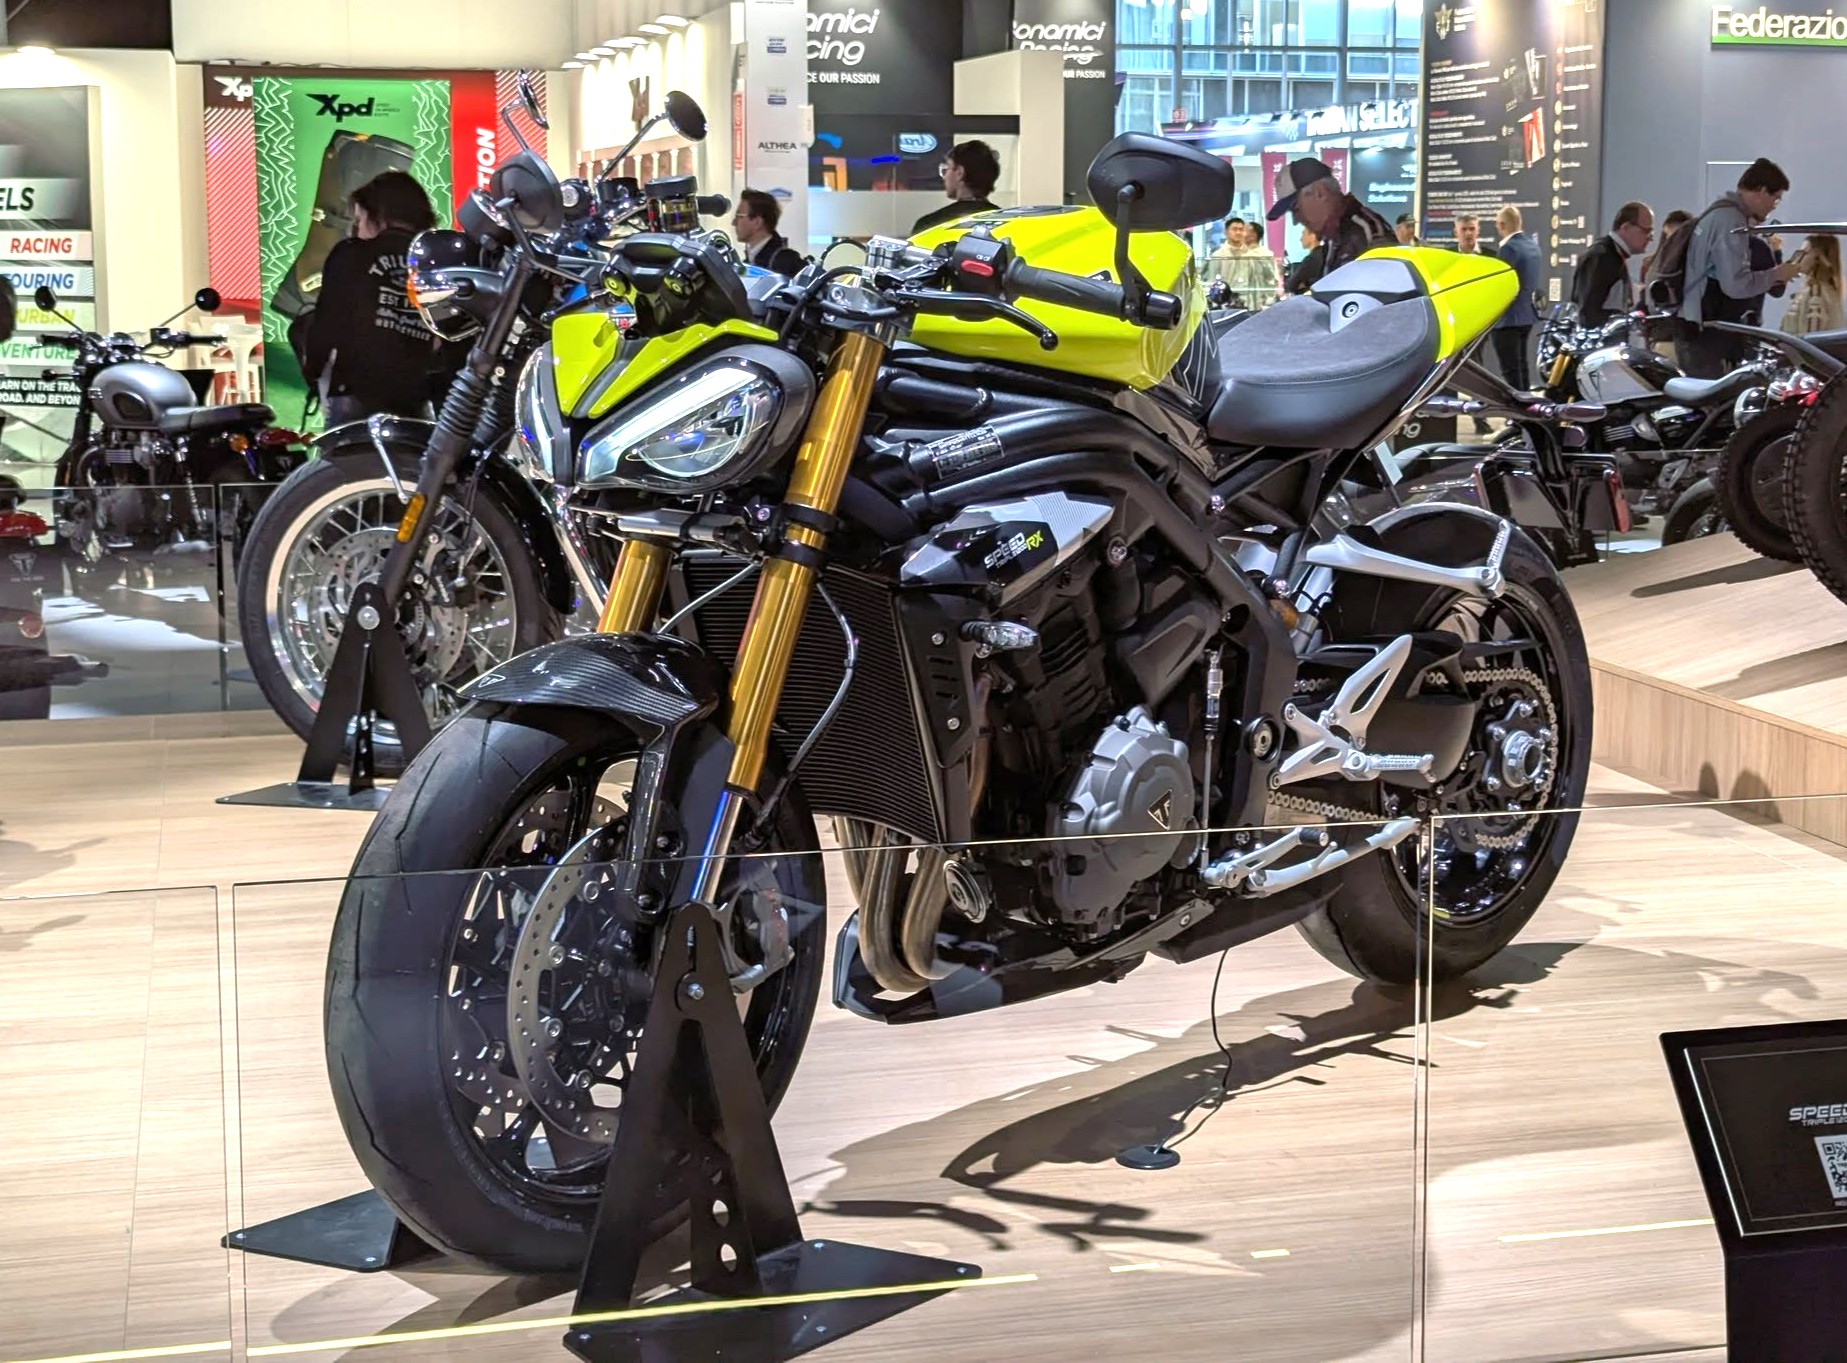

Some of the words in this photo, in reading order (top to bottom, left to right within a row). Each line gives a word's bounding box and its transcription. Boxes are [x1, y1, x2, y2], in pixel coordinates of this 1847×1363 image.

[1013, 20, 1107, 41] onamici
[1711, 4, 1847, 41] Federazio
[819, 72, 839, 83] OUR
[841, 72, 880, 84] PASSION
[1076, 70, 1105, 79] PASSION
[214, 76, 254, 102] Xp
[306, 93, 375, 123] Xpd
[758, 142, 798, 150] ALTHEA
[10, 238, 73, 254] RACING
[0, 379, 21, 391] ARN
[21, 380, 36, 391] ON
[37, 381, 57, 392] THE
[26, 393, 47, 404] AND
[984, 532, 1025, 569] SPEED
[1026, 530, 1044, 551] RX
